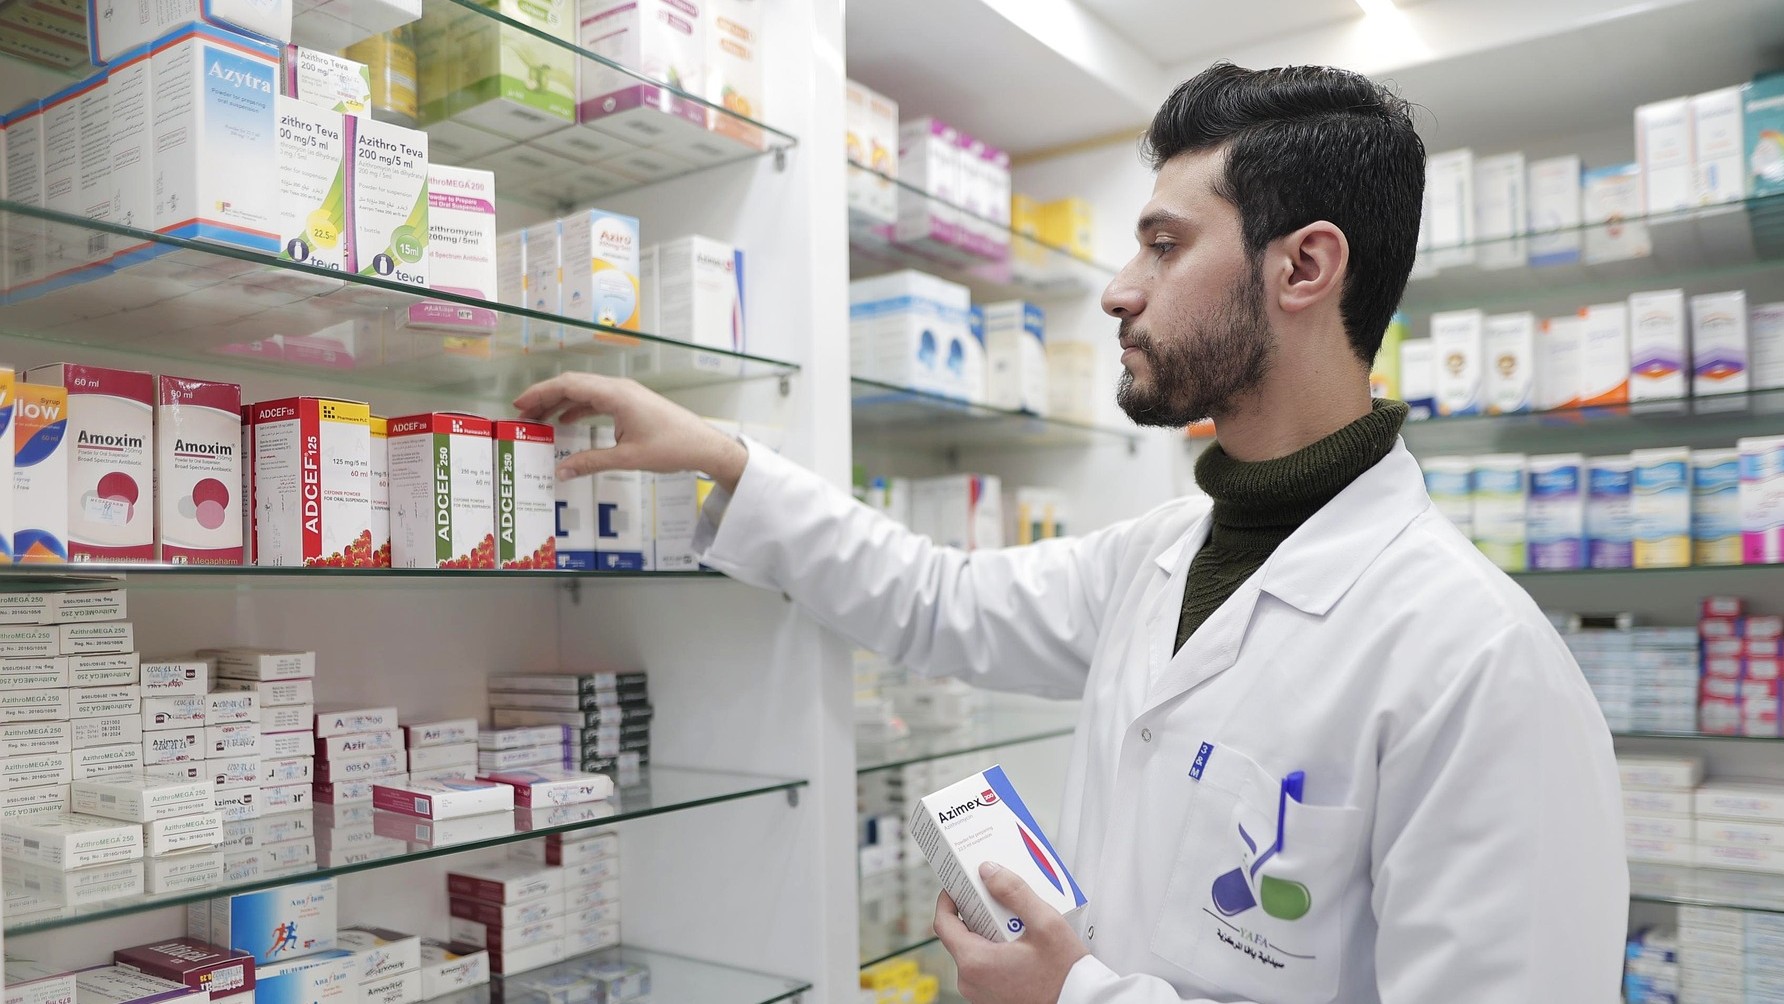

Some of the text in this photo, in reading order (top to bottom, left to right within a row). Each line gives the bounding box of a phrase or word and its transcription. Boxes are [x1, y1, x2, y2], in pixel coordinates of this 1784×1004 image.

[301, 51, 349, 71] Azithro Teva
[301, 61, 316, 72] 200
[209, 61, 271, 93] Azytra
[280, 115, 339, 140] zithro Teva
[280, 128, 291, 140] 00
[294, 135, 317, 147] mg/5
[359, 135, 424, 159] Azithro Teva
[359, 148, 413, 169] 200 mg/5 ml
[429, 177, 471, 190] throMEGA
[429, 194, 447, 202] owder
[430, 225, 483, 237] zithromycin
[396, 269, 425, 284] teva
[75, 378, 100, 388] 60 ml
[40, 396, 61, 405] Syrup
[171, 389, 194, 399] 60 ml
[259, 407, 287, 419] ADCEF
[392, 422, 418, 432] ADCEF
[77, 430, 142, 448] Amoxim
[174, 439, 232, 455] Amoxim
[304, 436, 318, 534] ADCEF 125
[437, 447, 450, 541] ADCEF 250
[501, 453, 513, 543] ADCEF 250
[0, 632, 36, 640] throMEGA
[343, 741, 366, 751] Azir
[983, 793, 994, 801] 200
[938, 797, 981, 824] Azimex
[1239, 926, 1268, 949] YAFA
